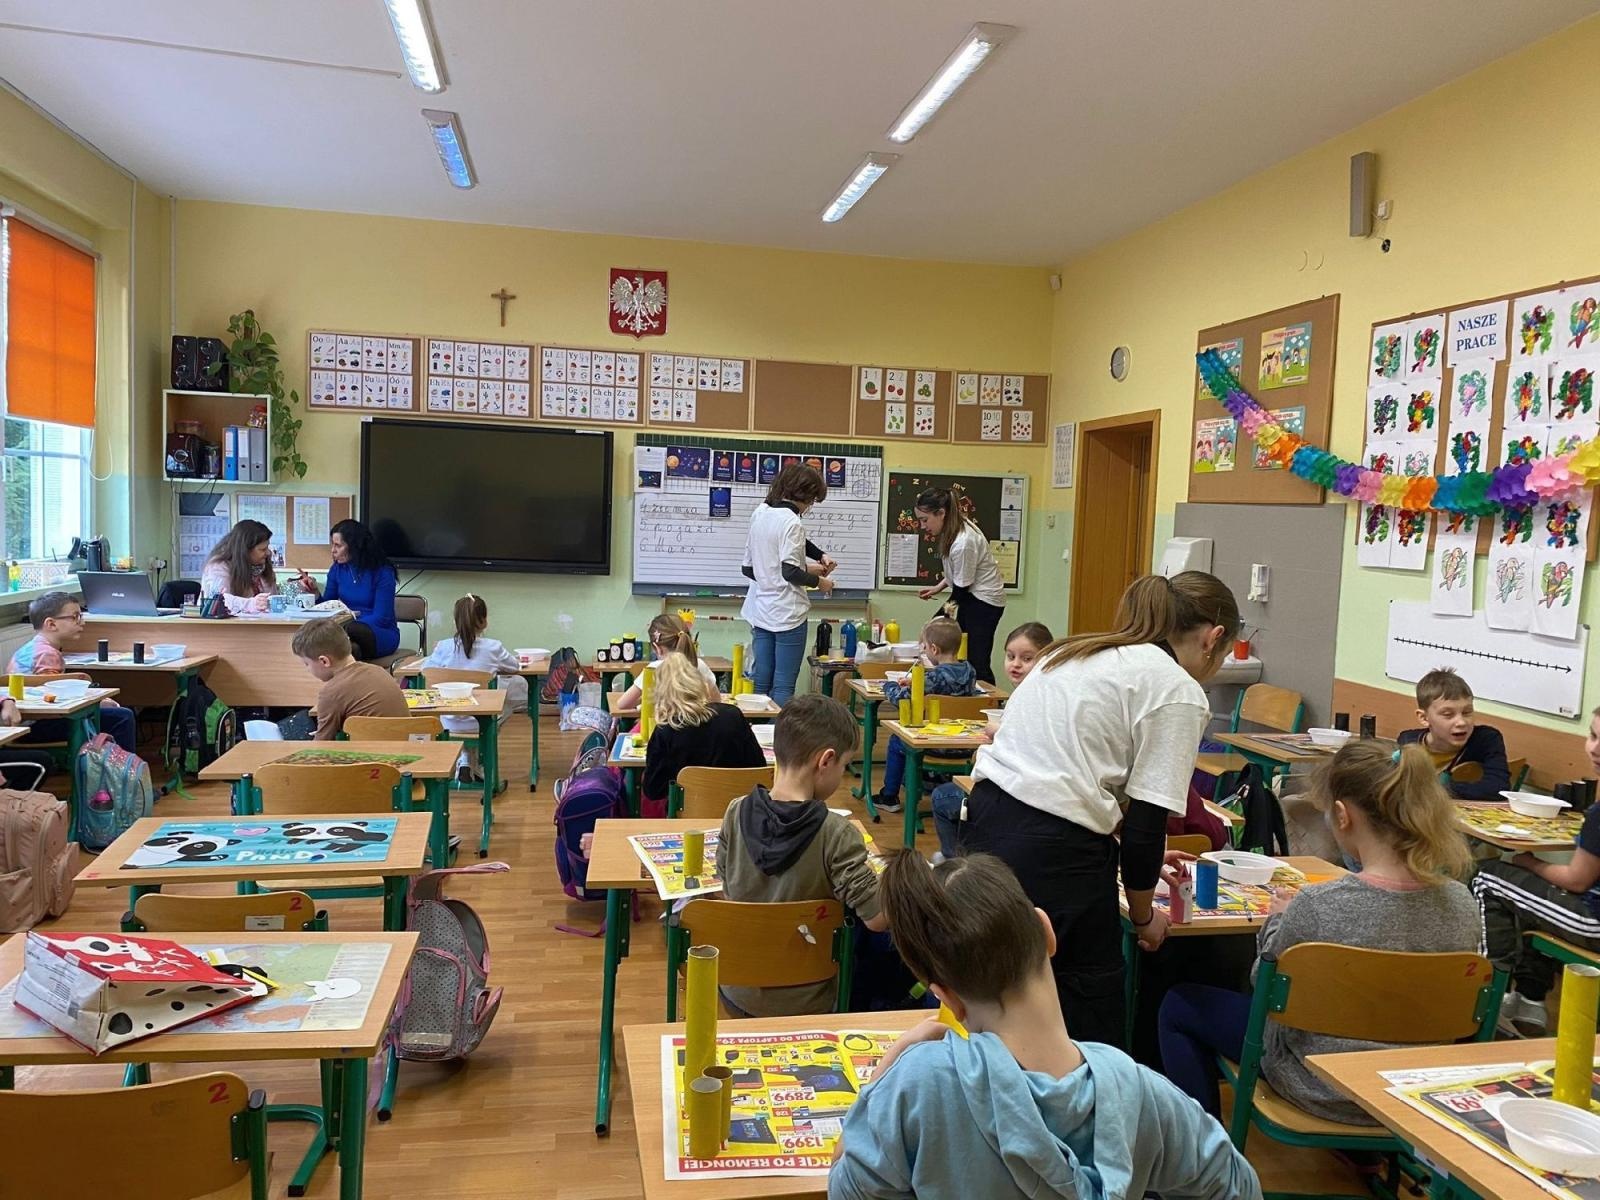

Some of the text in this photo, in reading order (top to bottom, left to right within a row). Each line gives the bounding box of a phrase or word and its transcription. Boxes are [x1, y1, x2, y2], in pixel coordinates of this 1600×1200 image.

[1458, 313, 1497, 332] NASZE
[1457, 333, 1497, 352] PRACE
[370, 768, 380, 780] 2
[290, 897, 302, 912] 2
[816, 905, 829, 920] 2
[1464, 962, 1478, 977] 2
[208, 1082, 230, 1104] 2
[684, 1158, 770, 1170] REMONCIE!
[772, 1157, 793, 1168] PO
